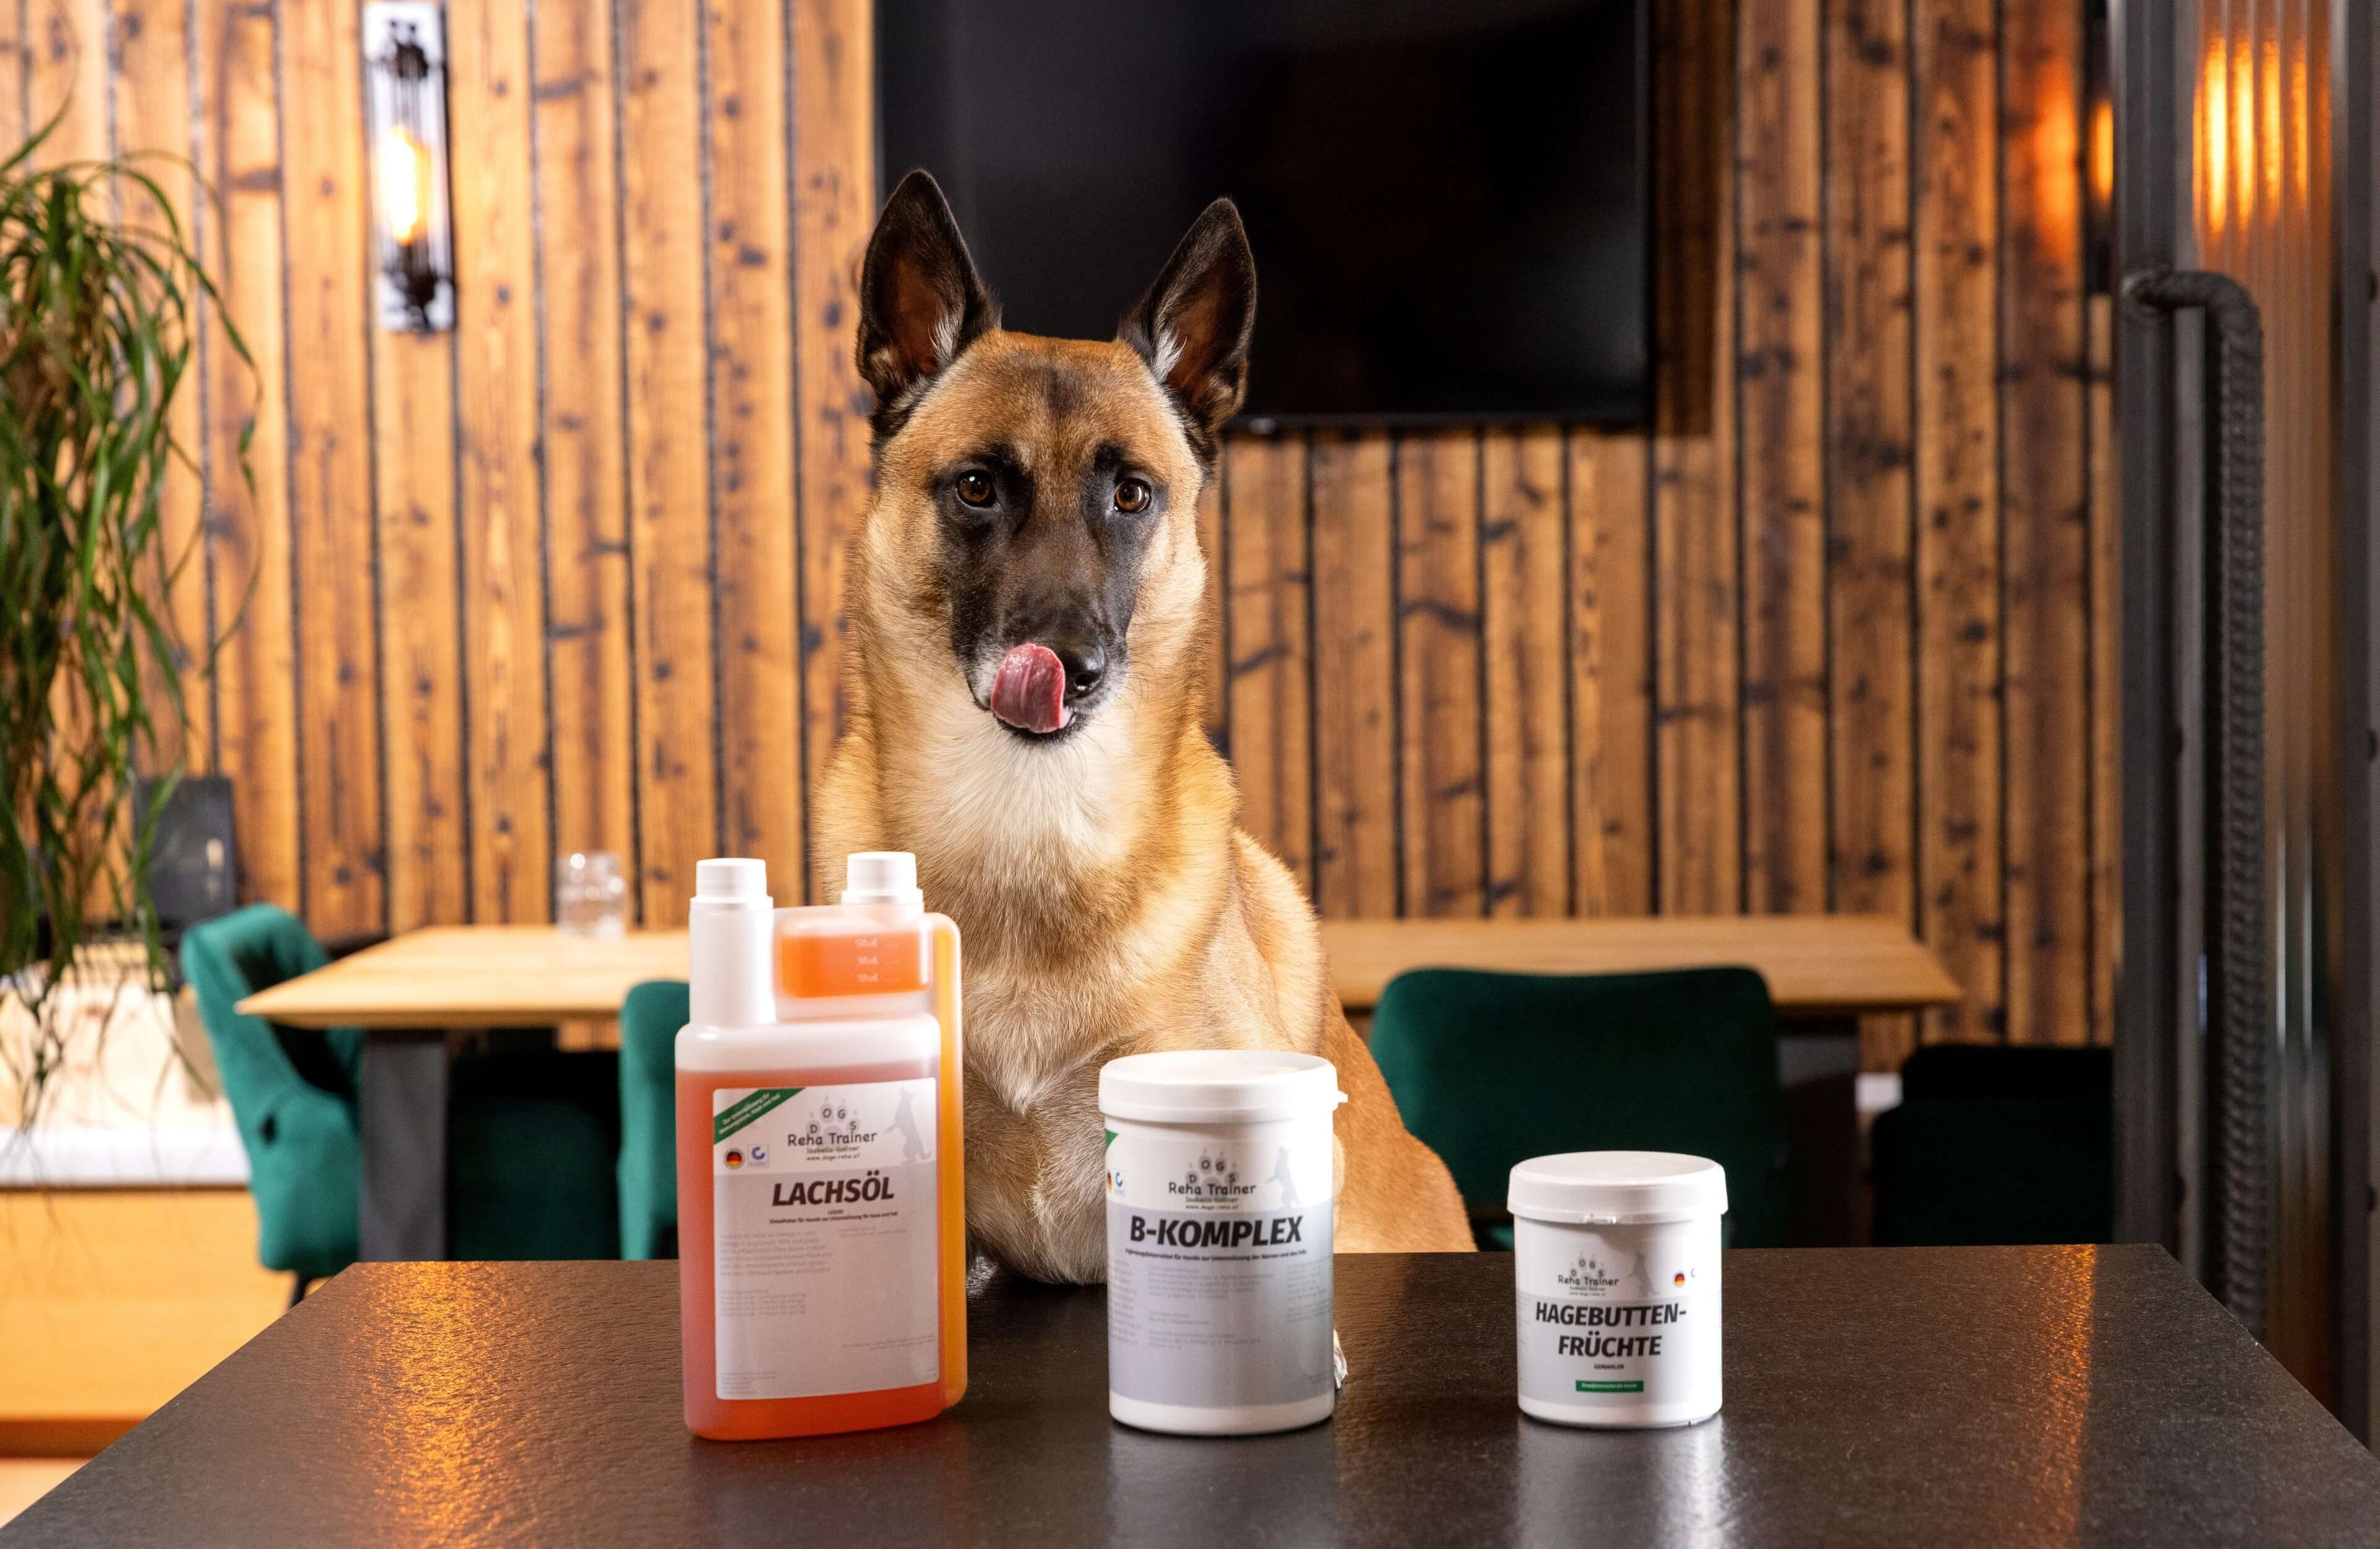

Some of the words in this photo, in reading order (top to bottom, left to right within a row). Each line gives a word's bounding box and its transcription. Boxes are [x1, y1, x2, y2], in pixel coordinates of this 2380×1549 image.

[787, 1132, 824, 1147] Reha
[827, 1131, 878, 1145] Trainer
[772, 1170, 895, 1207] LACHSÖL
[1168, 1181, 1202, 1195] Reha
[1206, 1183, 1257, 1196] Trainer
[1130, 1214, 1304, 1248] B-KOMPLEX
[1557, 1274, 1580, 1286] Reha
[1583, 1276, 1620, 1287] Trainer
[1535, 1301, 1687, 1327] HAGEBUTTEN-
[1558, 1331, 1662, 1357] FRÜCHTE
